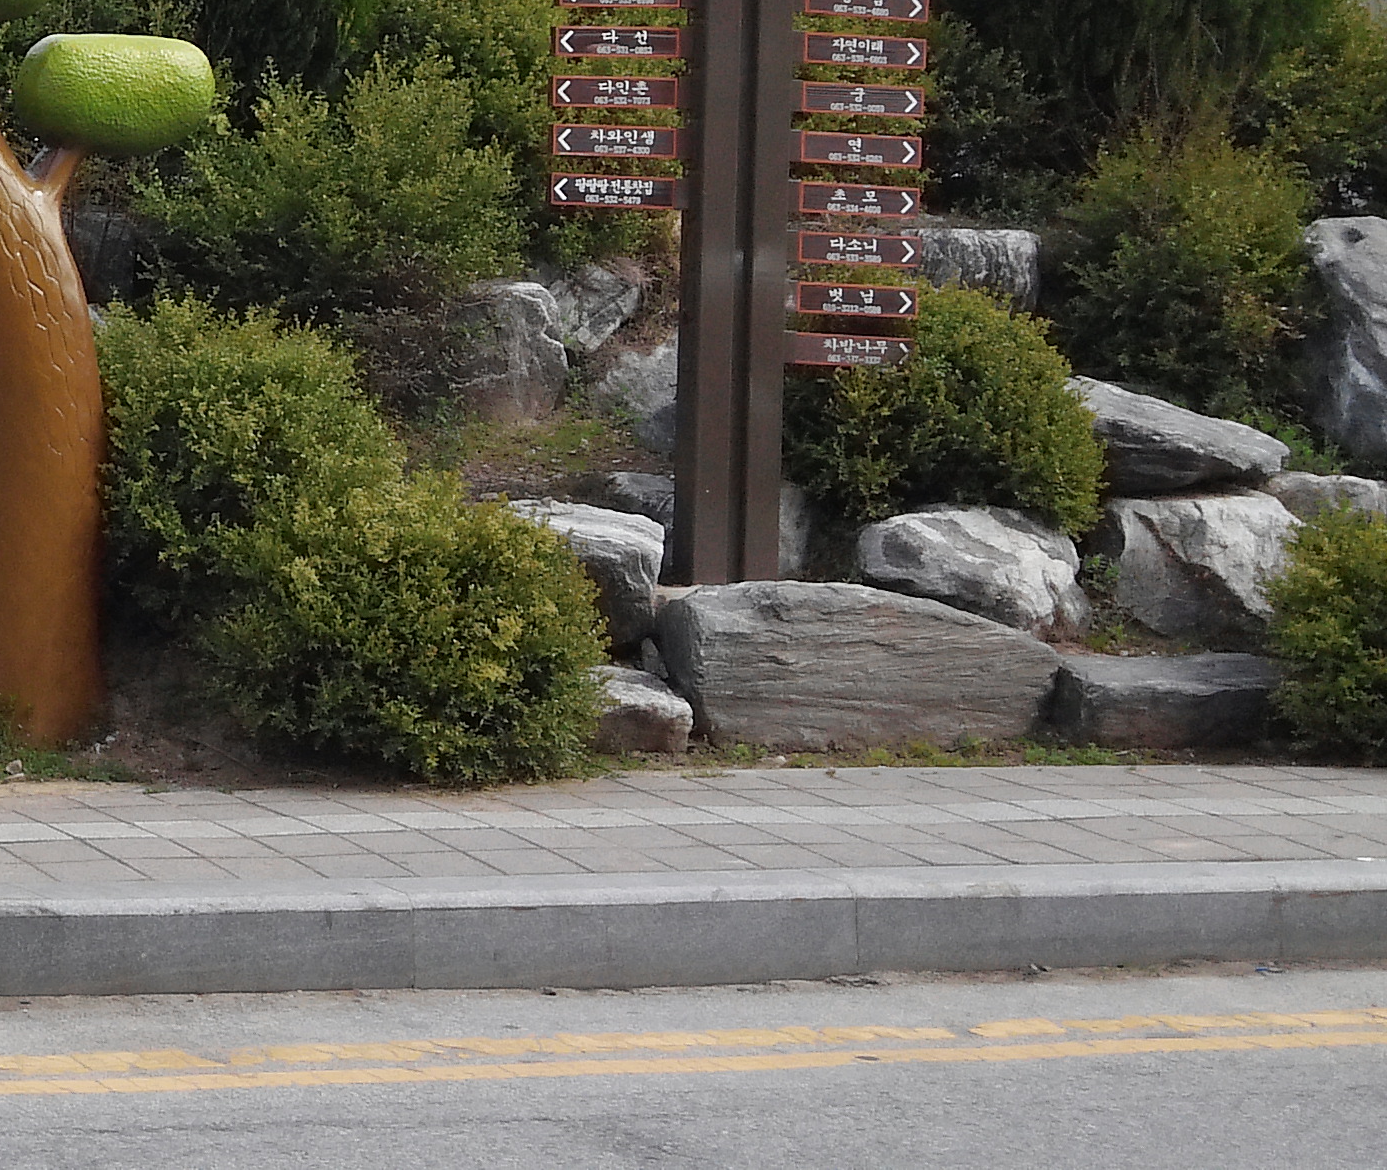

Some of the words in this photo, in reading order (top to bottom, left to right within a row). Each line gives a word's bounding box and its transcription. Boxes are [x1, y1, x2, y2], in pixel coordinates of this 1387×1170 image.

[601, 29, 648, 46] 다선
[832, 37, 884, 54] 자연이래
[850, 87, 865, 103] 궁
[589, 129, 655, 145] 차와인생
[830, 188, 878, 203] 초모
[829, 236, 877, 253] 다소니
[828, 288, 875, 305] 벗님
